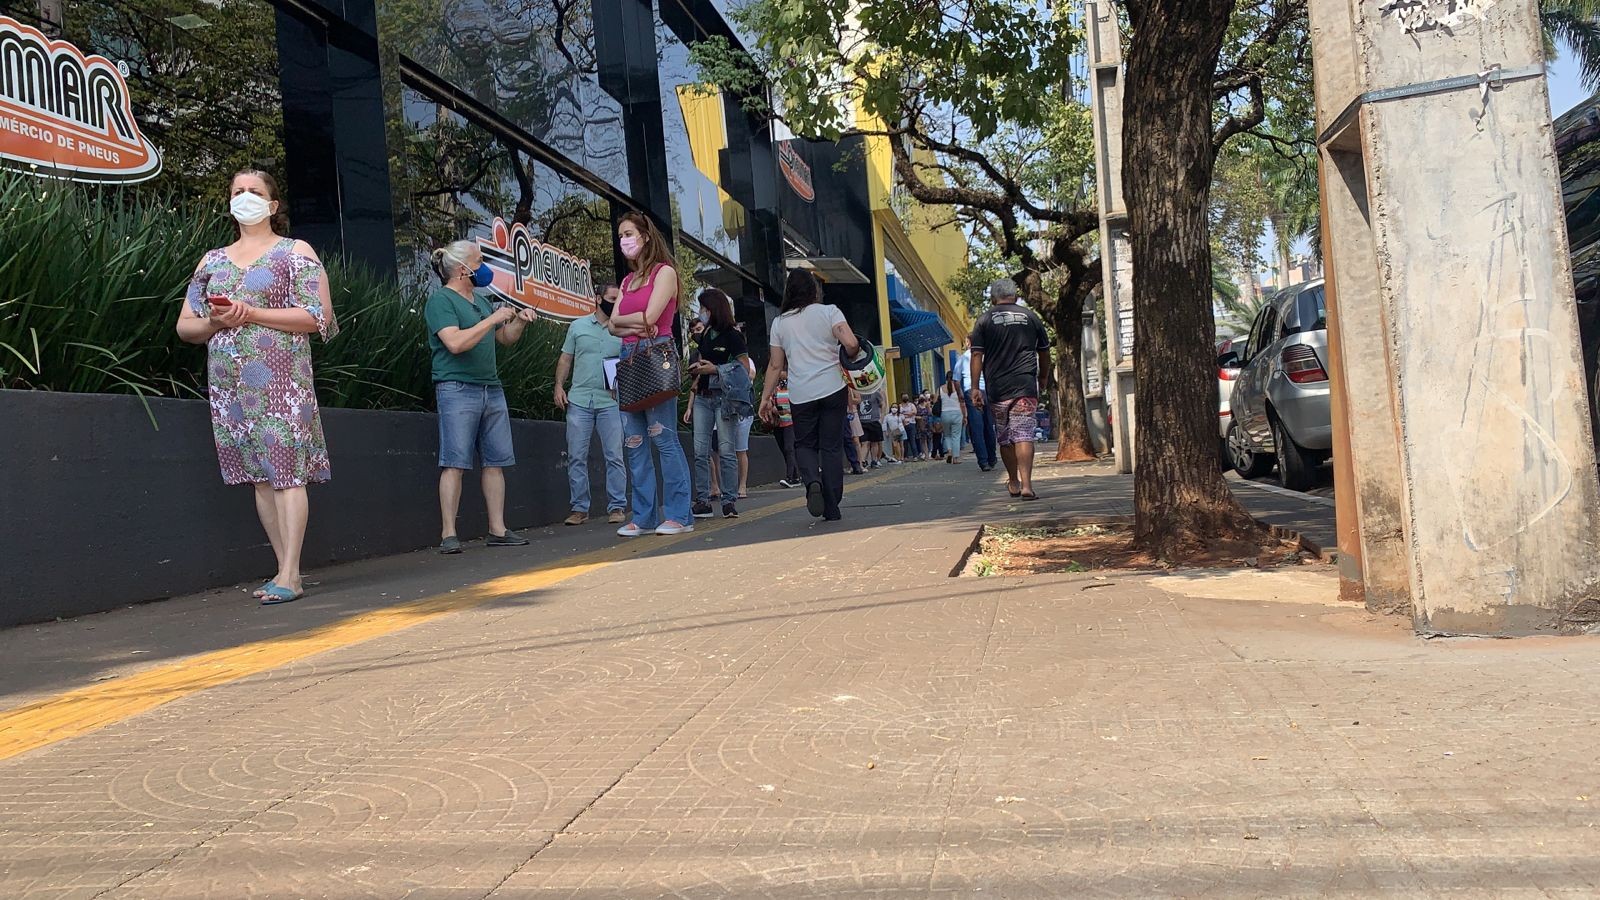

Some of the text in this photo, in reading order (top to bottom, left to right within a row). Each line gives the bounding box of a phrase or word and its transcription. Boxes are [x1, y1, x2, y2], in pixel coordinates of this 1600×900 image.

[57, 134, 75, 150] DE
[78, 141, 120, 164] PNEUS
[511, 228, 594, 299] PNEUMAR
